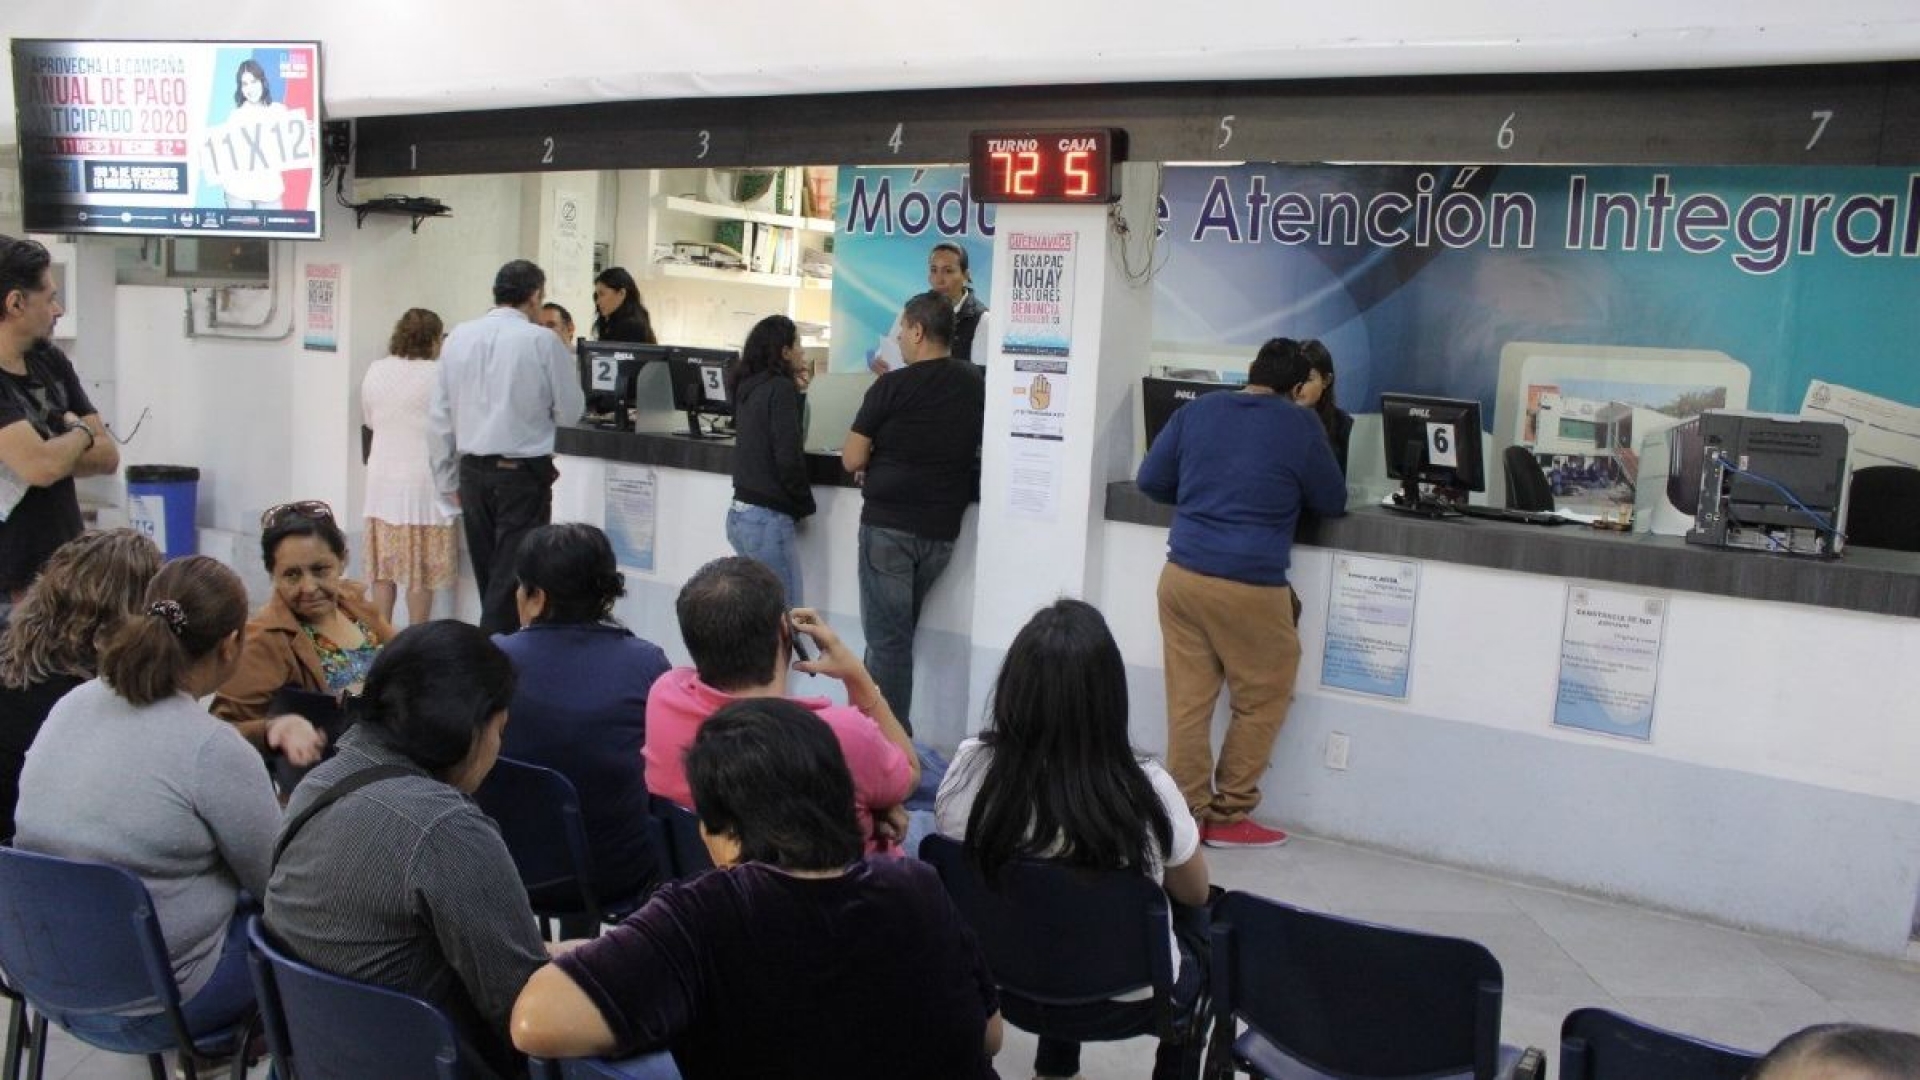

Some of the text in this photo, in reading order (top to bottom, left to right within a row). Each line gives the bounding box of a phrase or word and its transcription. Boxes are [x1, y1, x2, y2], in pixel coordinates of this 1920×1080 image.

[31, 56, 102, 74] APROVECHA
[28, 77, 186, 105] ANUAL DE PAGO
[140, 109, 188, 134] 2020
[1218, 115, 1236, 150] 5
[1497, 112, 1516, 150] 6
[1804, 111, 1833, 150] 7
[541, 136, 555, 163] 2
[697, 130, 710, 159] 3
[888, 122, 903, 154] 4
[987, 138, 1098, 153] TURNO CAJA
[410, 144, 418, 170] 1
[991, 151, 1090, 196] 72 5
[846, 168, 996, 237] Módu
[1190, 167, 1537, 248] Atención
[1565, 173, 1920, 275] Integral
[597, 361, 612, 382] 2
[706, 371, 719, 390] 3
[1433, 427, 1449, 454] 6
